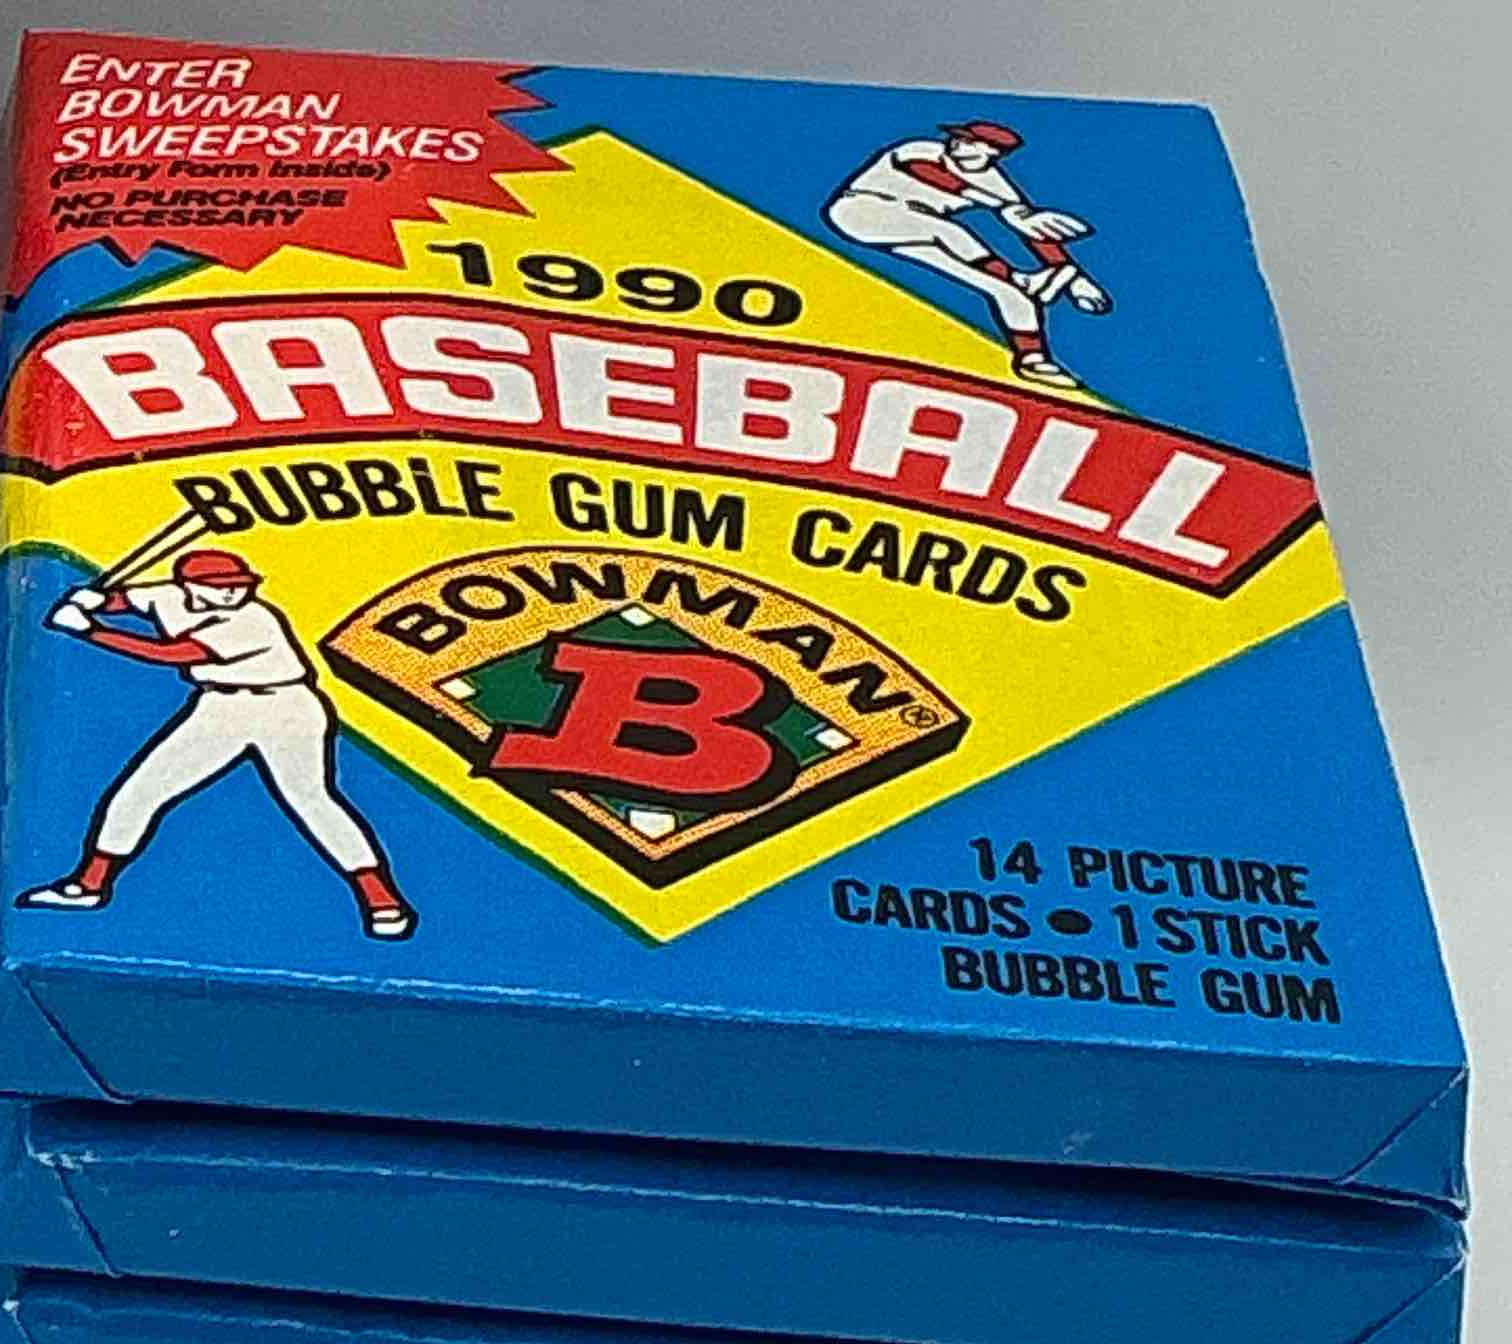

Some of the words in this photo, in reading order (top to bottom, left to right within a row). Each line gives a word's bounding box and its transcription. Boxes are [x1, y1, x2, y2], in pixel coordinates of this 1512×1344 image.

[57, 89, 340, 123] BOWMAN
[60, 54, 253, 88] ENTER
[53, 124, 484, 163] SWEEPSTAKES
[168, 161, 259, 179] Form
[51, 191, 115, 215] NO
[125, 189, 348, 209] PURCHASE
[55, 208, 304, 232] NECESSARY
[426, 242, 802, 327] 1990
[43, 314, 1231, 569] BASEBALL
[173, 458, 514, 534] BUBBLE
[550, 473, 746, 551] GUM
[791, 508, 1088, 622] CARDS
[491, 644, 773, 794] B
[970, 837, 1042, 884] 14
[1066, 845, 1315, 908] PICTURE
[831, 878, 1031, 939] CARDS
[1111, 904, 1139, 949] 1
[1153, 908, 1329, 966] STICK
[941, 945, 1177, 1008] BUBBLE
[1201, 968, 1340, 1024] GUM
